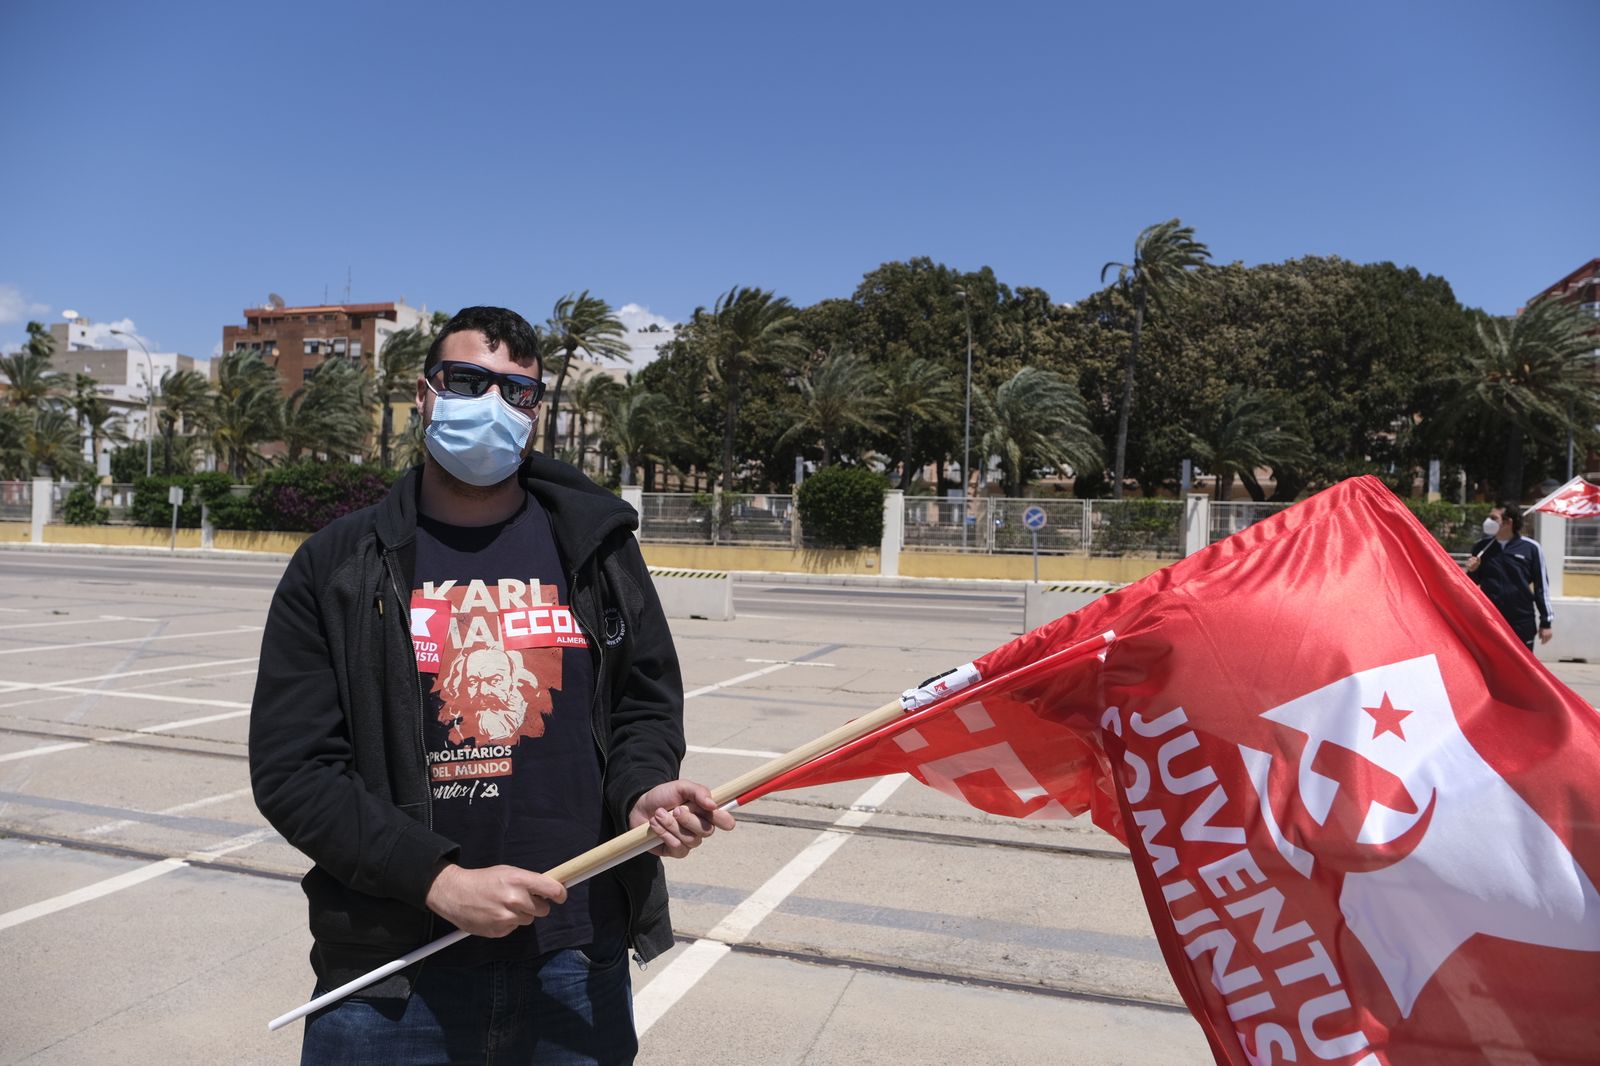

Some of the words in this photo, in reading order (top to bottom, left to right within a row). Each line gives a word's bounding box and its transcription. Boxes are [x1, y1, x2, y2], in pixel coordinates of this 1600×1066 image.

[422, 578, 553, 614] KARL
[432, 767, 451, 778] DEL
[455, 761, 510, 777] MUNDO
[1130, 706, 1382, 1066] JUVENTU
